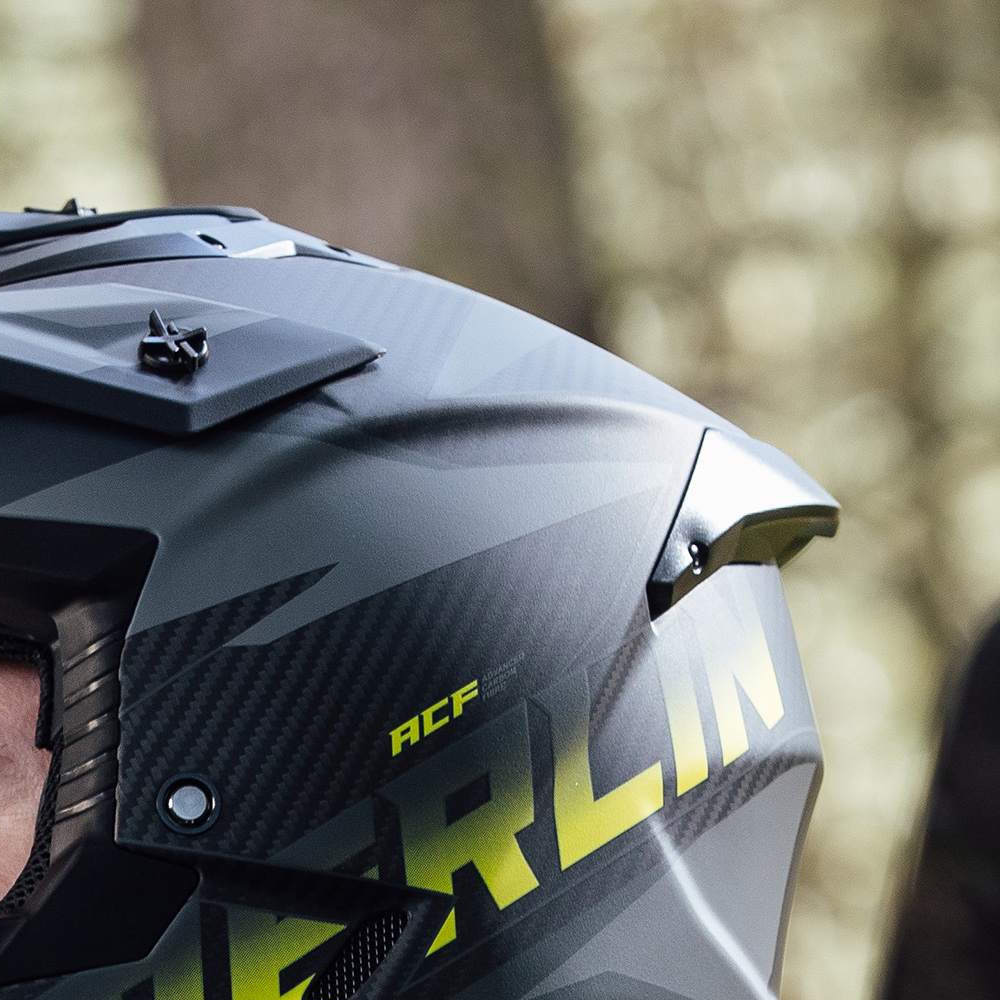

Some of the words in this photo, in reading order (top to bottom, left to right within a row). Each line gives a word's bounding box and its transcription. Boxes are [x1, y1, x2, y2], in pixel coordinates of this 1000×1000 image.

[481, 666, 517, 692] CARBON
[482, 652, 525, 682] ADVANCED
[389, 679, 478, 757] ACF
